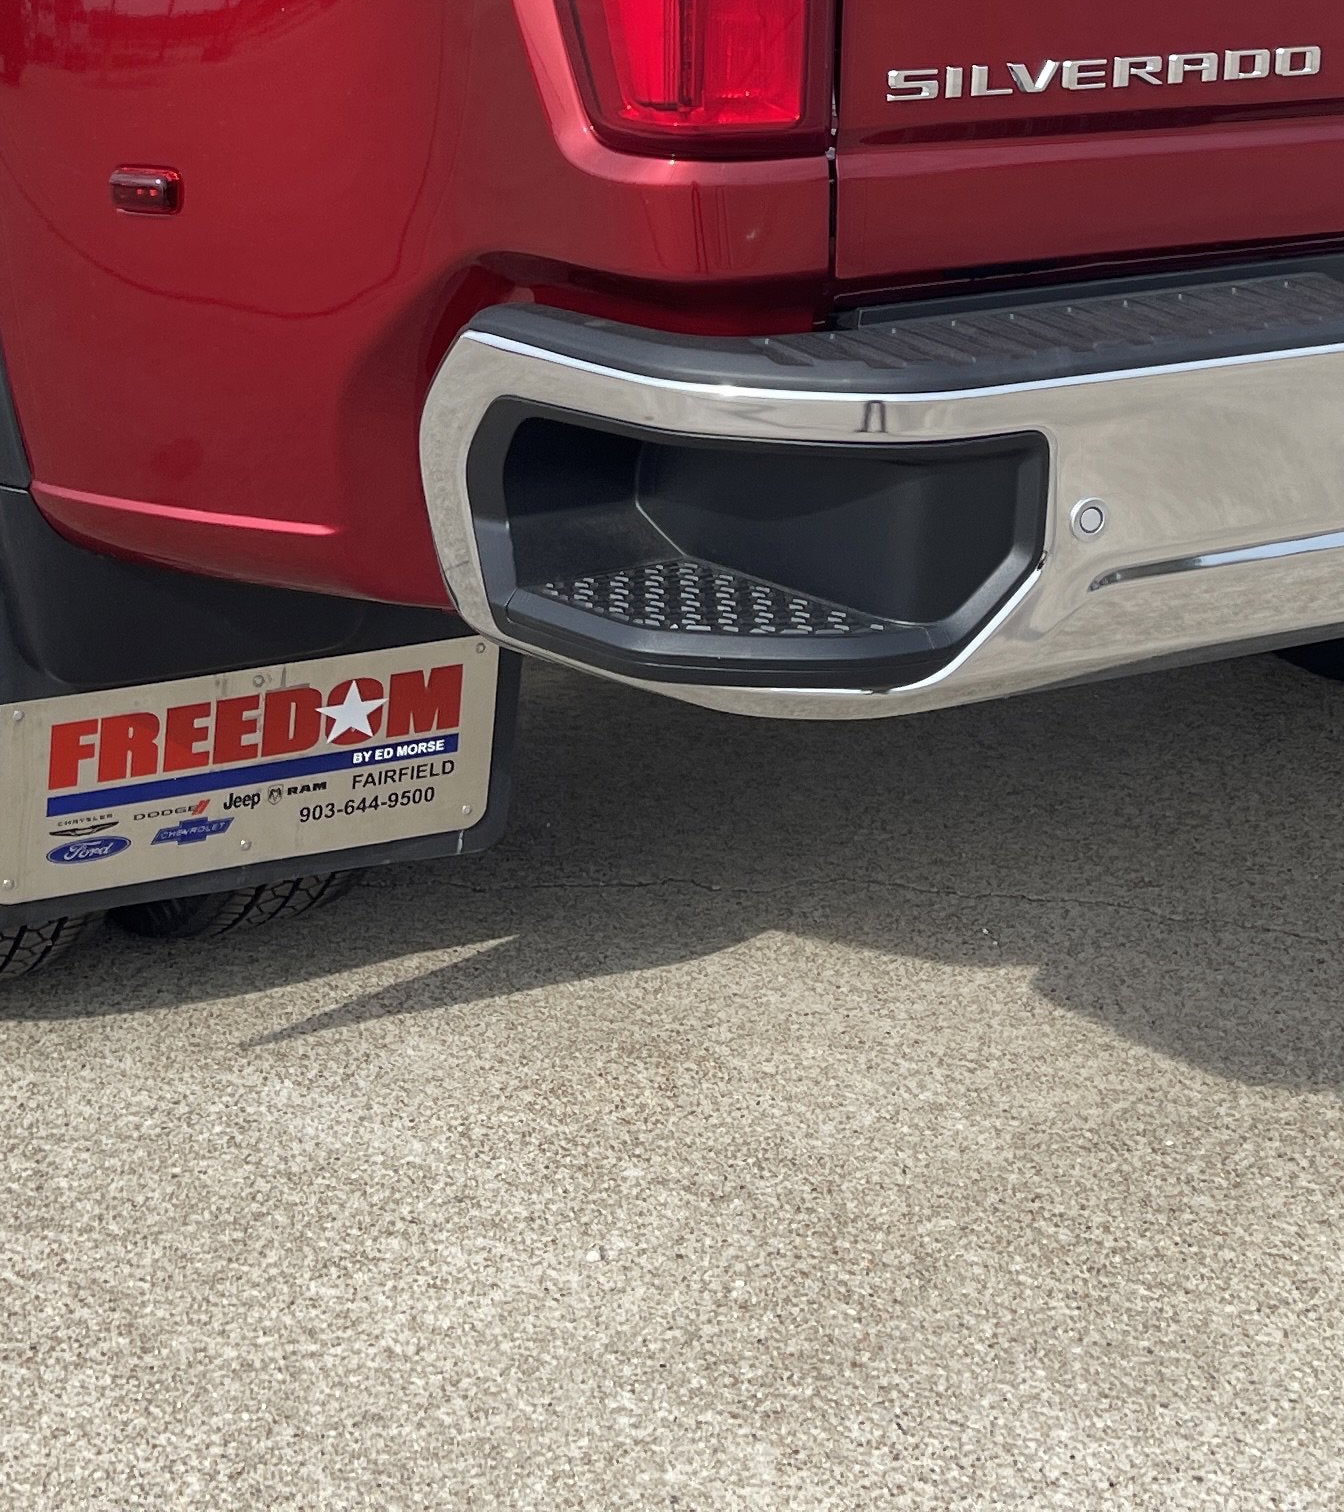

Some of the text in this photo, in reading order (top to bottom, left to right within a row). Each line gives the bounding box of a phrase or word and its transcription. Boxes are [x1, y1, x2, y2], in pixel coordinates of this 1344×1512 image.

[886, 45, 1322, 102] SILVERADO
[48, 664, 464, 791] FREEDOM
[352, 739, 445, 764] BY ED MORSE
[352, 759, 455, 790] FAIRFIELD
[287, 782, 327, 795] RAM
[223, 792, 261, 809] Jeep
[299, 786, 435, 823] 903-644-9500
[57, 813, 113, 827] CHRYSLER
[133, 804, 198, 821] DODGE
[160, 822, 226, 839] CHEVROLET
[63, 840, 111, 861] Ford
